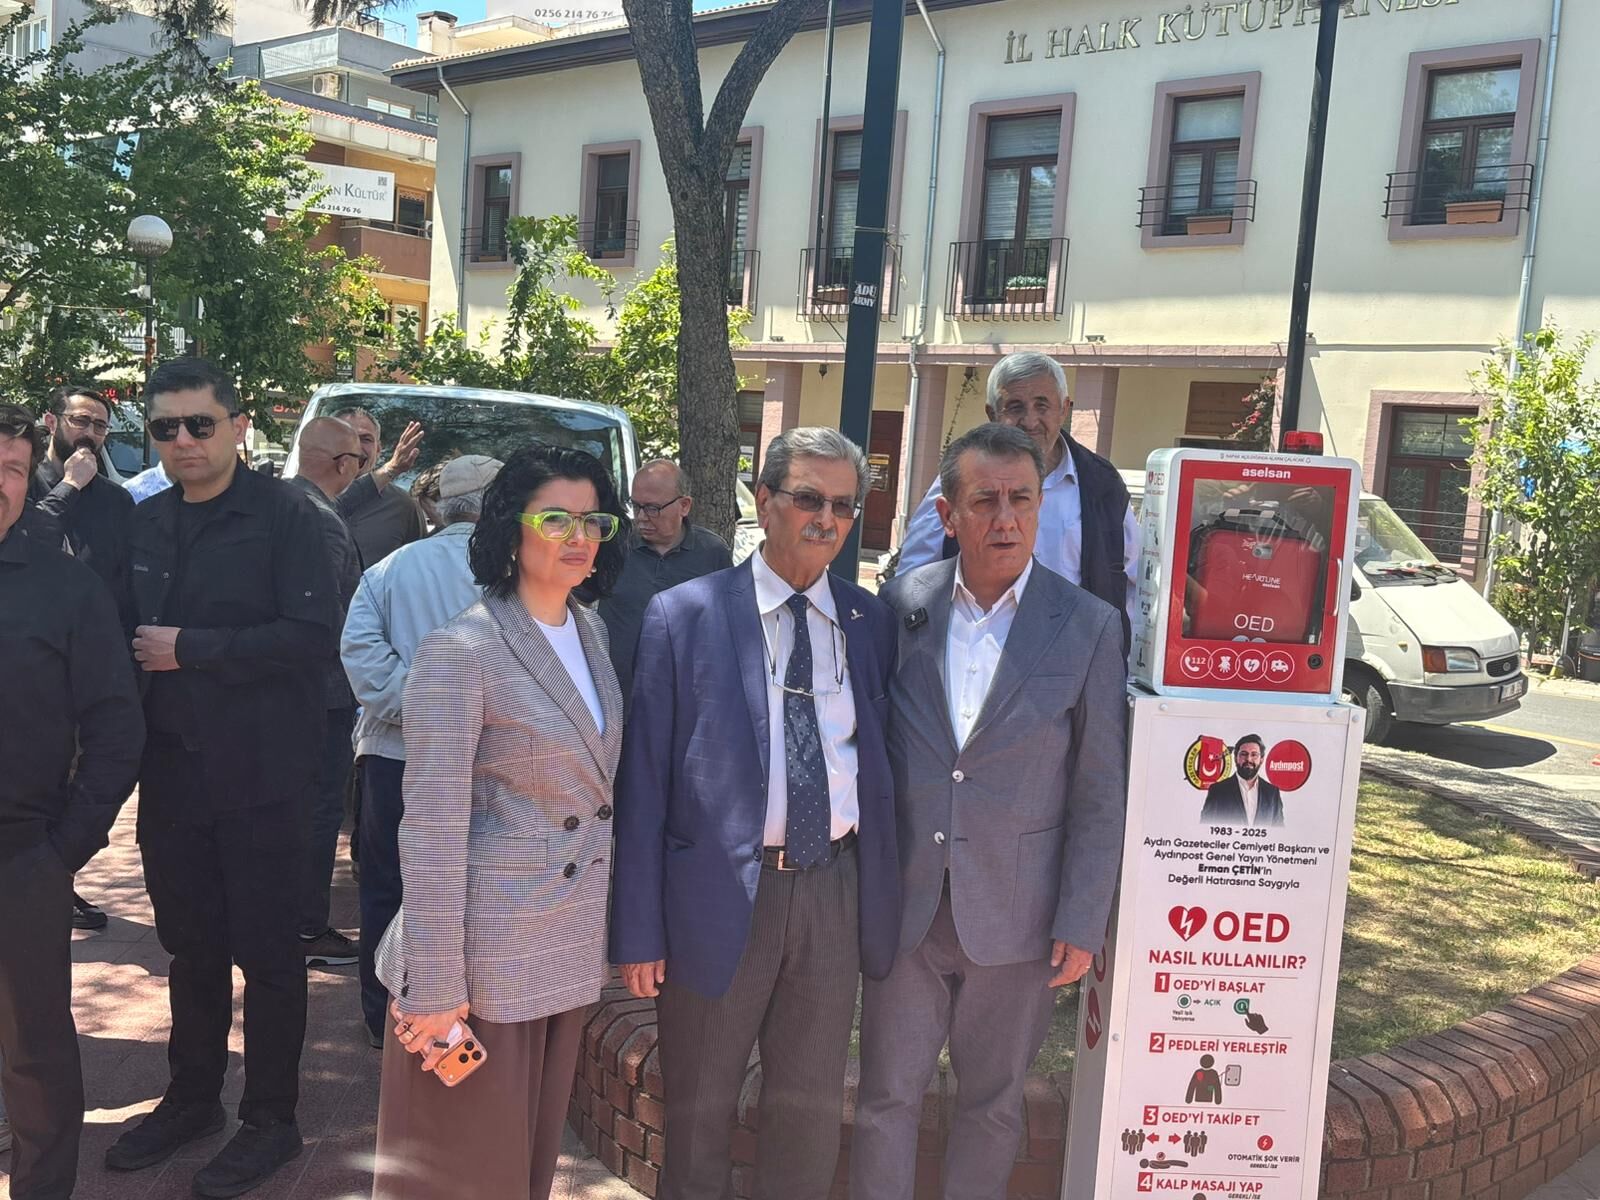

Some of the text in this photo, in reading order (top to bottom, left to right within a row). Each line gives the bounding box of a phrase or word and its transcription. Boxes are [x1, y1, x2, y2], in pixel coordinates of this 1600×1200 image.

[534, 8, 562, 18] 0256
[565, 9, 583, 19] 214
[586, 10, 599, 19] 76
[1004, 30, 1033, 64] İL
[1044, 18, 1142, 60] HALK
[342, 205, 351, 213] 76
[1241, 467, 1291, 479] aselsan
[1234, 613, 1275, 633] OED
[1191, 657, 1206, 665] 112
[1209, 826, 1233, 836] 1983
[1242, 828, 1267, 838] 2025
[1143, 836, 1330, 855] Aydın Gazeteciler Cemiyeti Başkanı ve
[1154, 849, 1318, 866] Aydınpost Genel Yayın Yönetmeni
[1198, 863, 1230, 874] Erman
[1168, 873, 1300, 890] Değerli Hatırasına Saygıyla
[1213, 911, 1290, 943] OED
[1149, 950, 1307, 970] NASIL KULLANILIR?
[1219, 981, 1266, 994] BAŞLAT
[1203, 999, 1221, 1007] AÇIK
[1168, 1039, 1220, 1052] PEDLERİ
[1222, 1040, 1288, 1055] YERLEŞTİR
[1207, 1112, 1242, 1126] TAKİP
[1245, 1115, 1260, 1126] ET
[1227, 1153, 1300, 1163] OTOMATİK ŞOK VERİR
[1156, 1178, 1188, 1190] KALP
[1191, 1179, 1236, 1192] MASAJI
[1239, 1182, 1263, 1193] YAP
